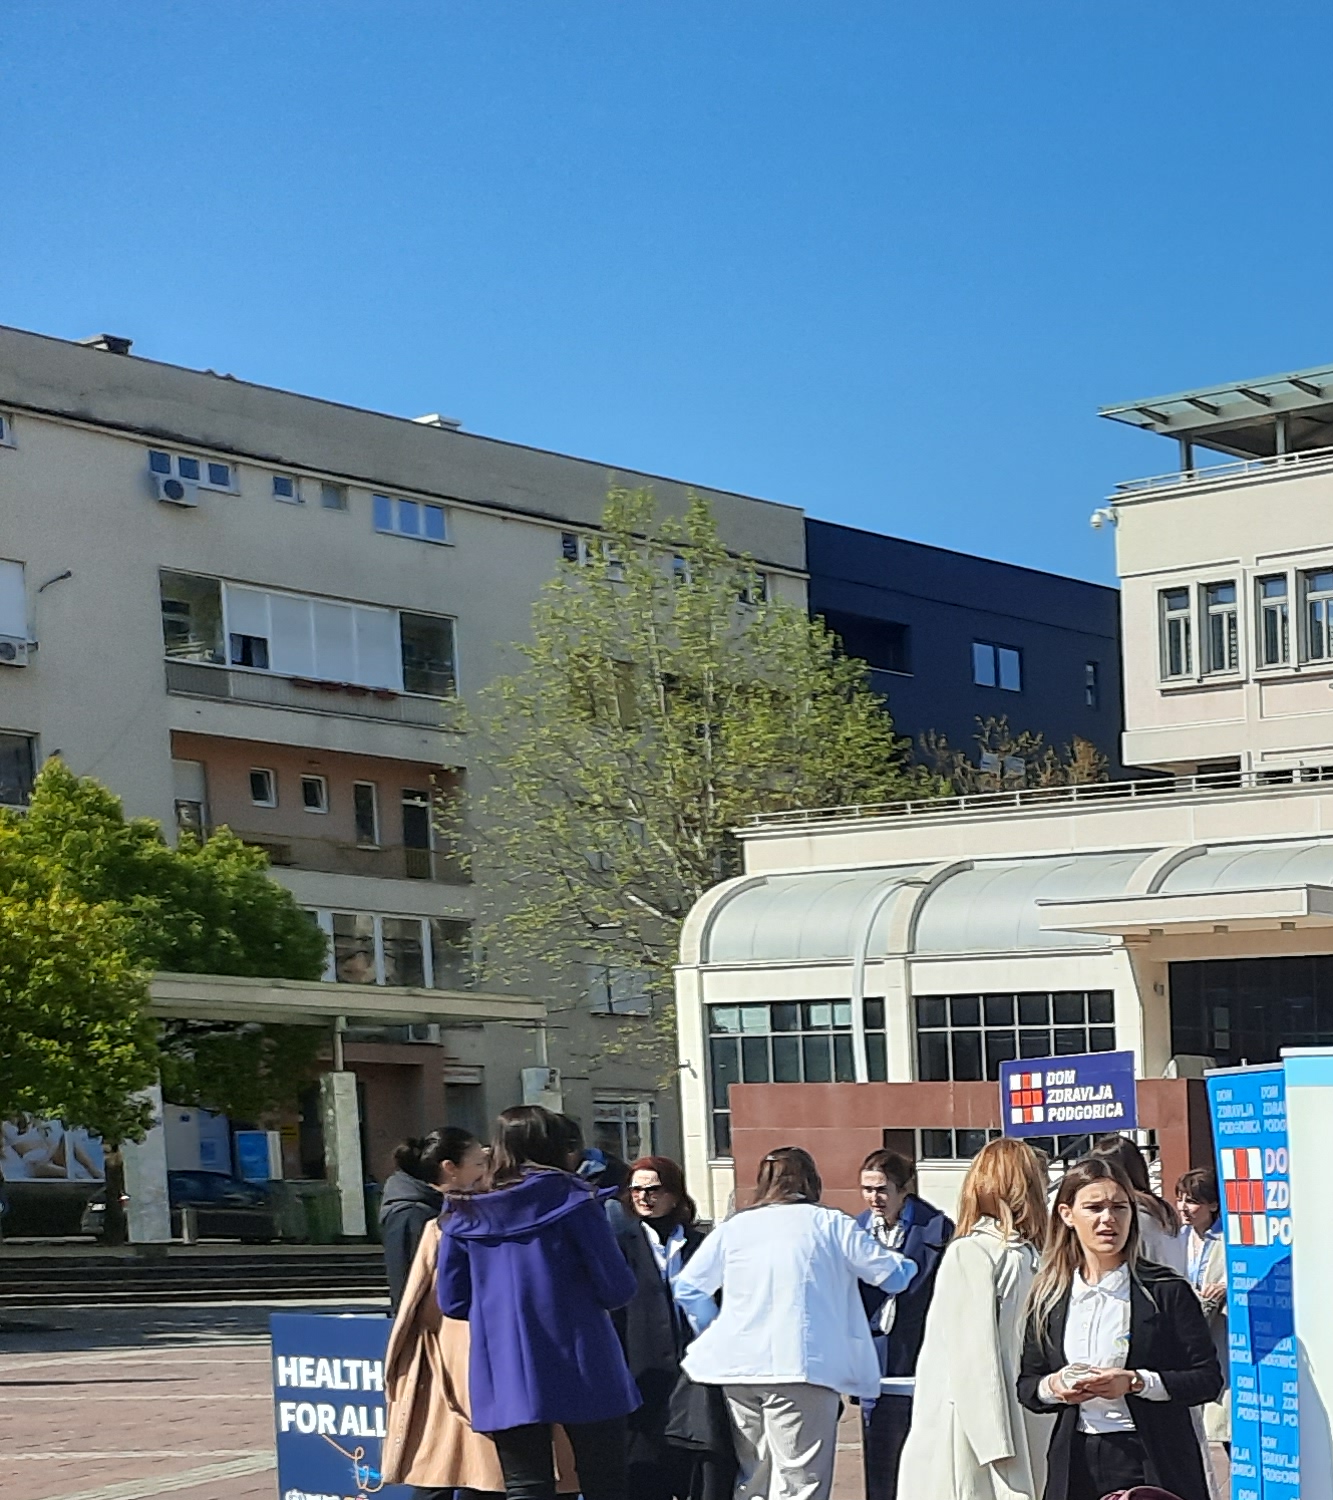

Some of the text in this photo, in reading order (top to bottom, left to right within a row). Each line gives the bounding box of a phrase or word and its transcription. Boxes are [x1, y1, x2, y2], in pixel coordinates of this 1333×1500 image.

[1046, 1070, 1076, 1086] DOM
[1046, 1085, 1113, 1104] ZDRAVLJA
[1216, 1089, 1233, 1102] DOM
[1260, 1085, 1279, 1099] DOM
[1048, 1102, 1123, 1122] PODGORICA
[277, 1355, 384, 1392] HEALTH
[279, 1402, 387, 1438] FOR ALL
